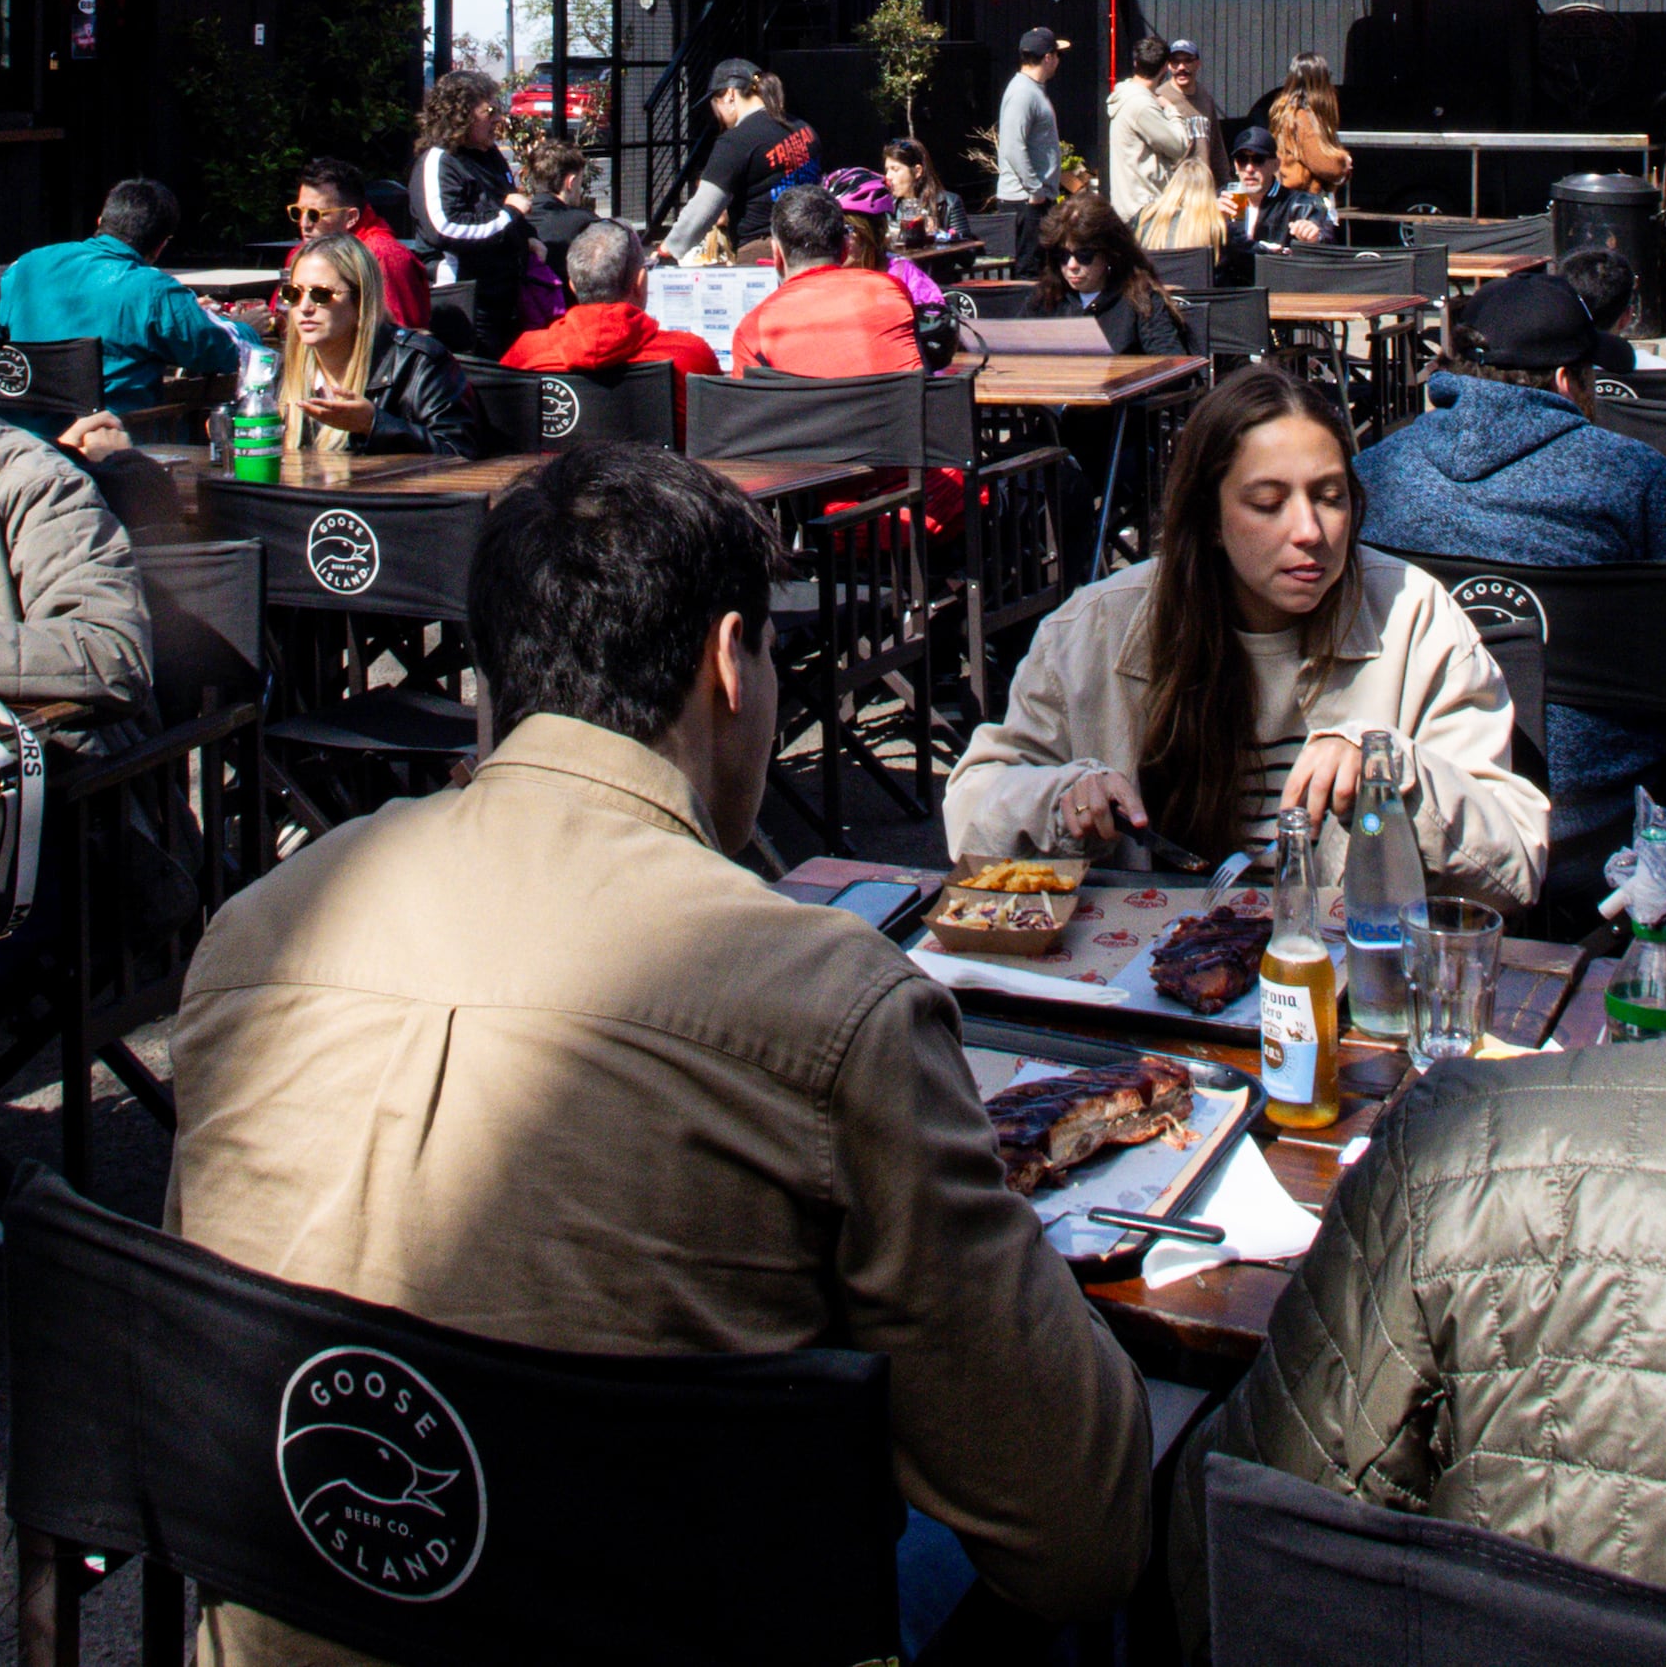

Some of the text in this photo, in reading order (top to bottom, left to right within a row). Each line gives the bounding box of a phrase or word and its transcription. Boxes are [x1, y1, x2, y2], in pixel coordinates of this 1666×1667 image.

[319, 516, 364, 537] GOOSE
[320, 567, 368, 589] ISLAND
[1461, 581, 1528, 608] GOOSE
[309, 1368, 438, 1439] GOOSE
[344, 1505, 415, 1538] BEER CO.
[314, 1510, 450, 1582] ISLAND
